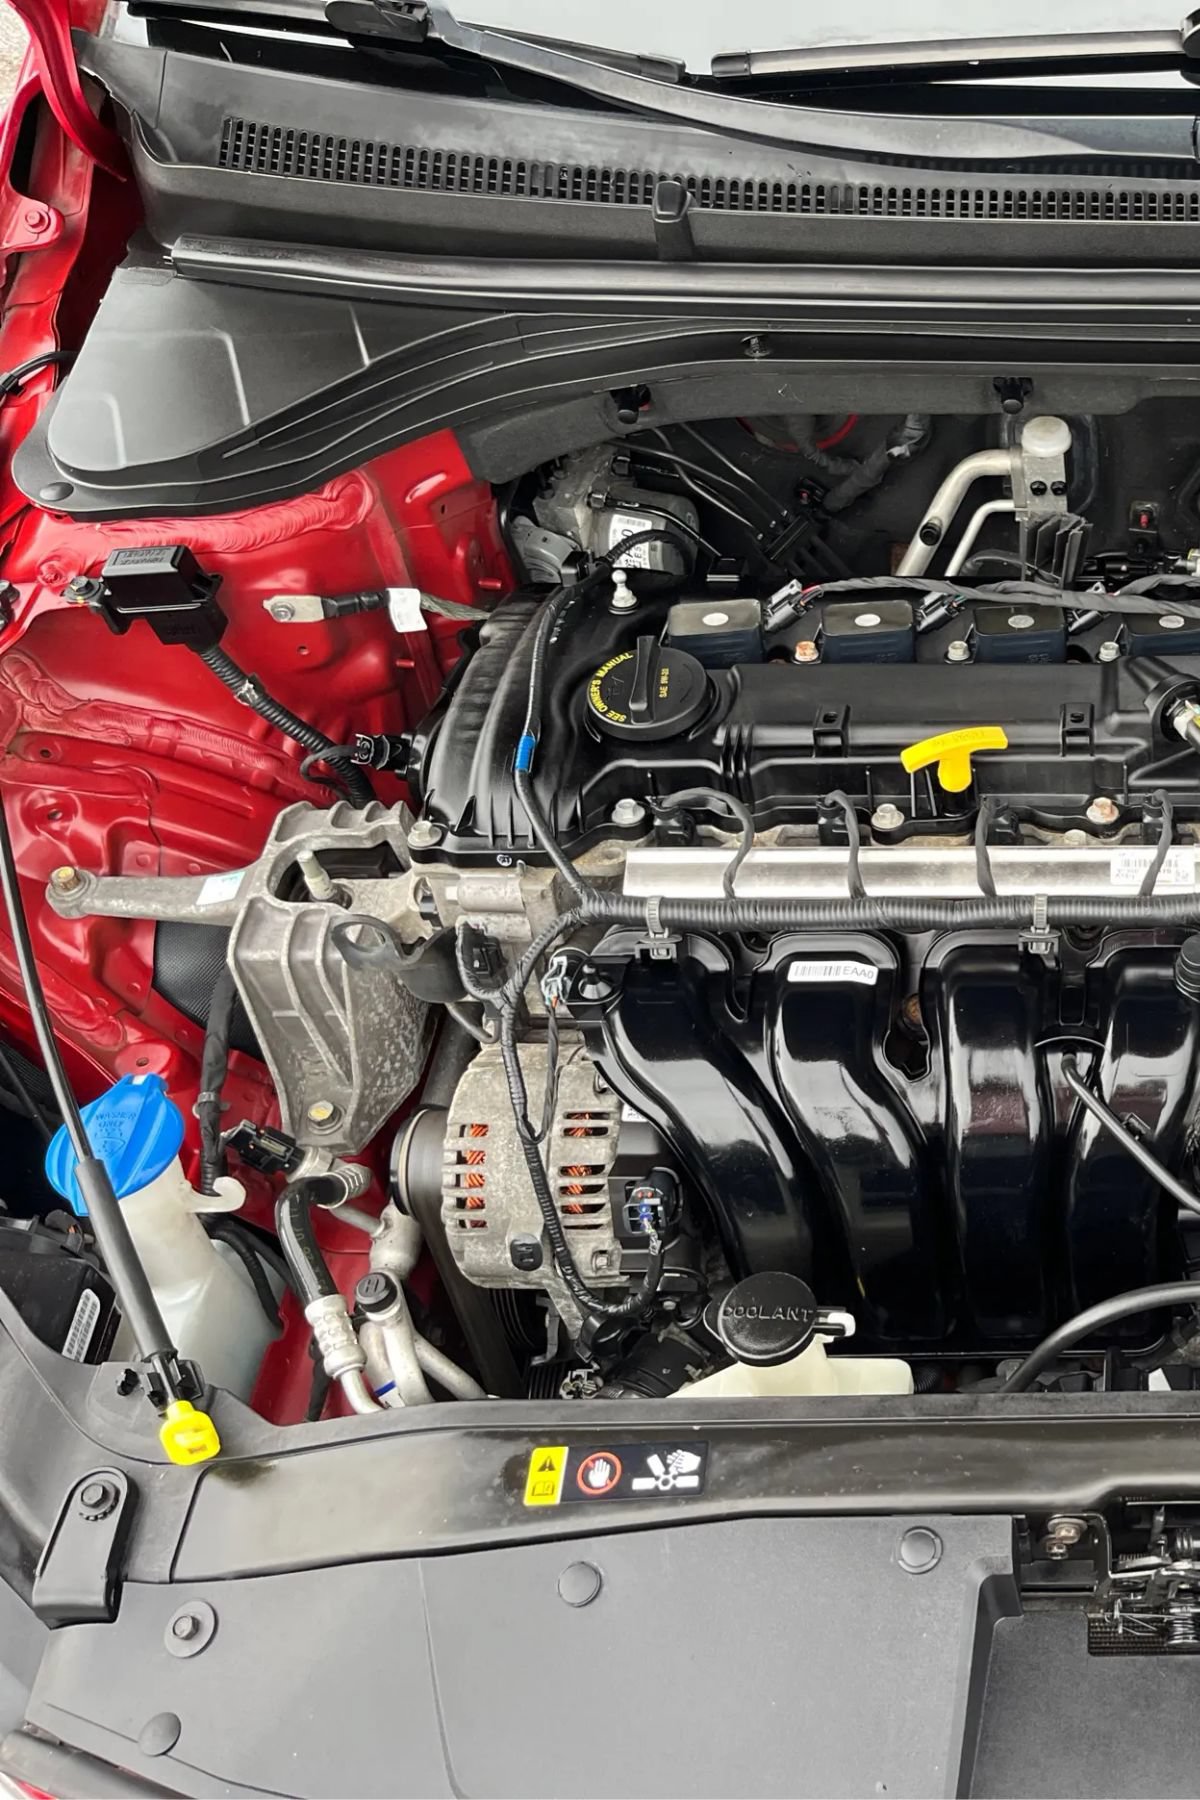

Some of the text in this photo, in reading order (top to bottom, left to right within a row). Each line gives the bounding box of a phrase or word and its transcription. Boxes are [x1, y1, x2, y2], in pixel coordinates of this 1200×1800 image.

[590, 652, 634, 722] SEE OWNER'S MANUAL
[721, 1304, 814, 1323] COOLANT
